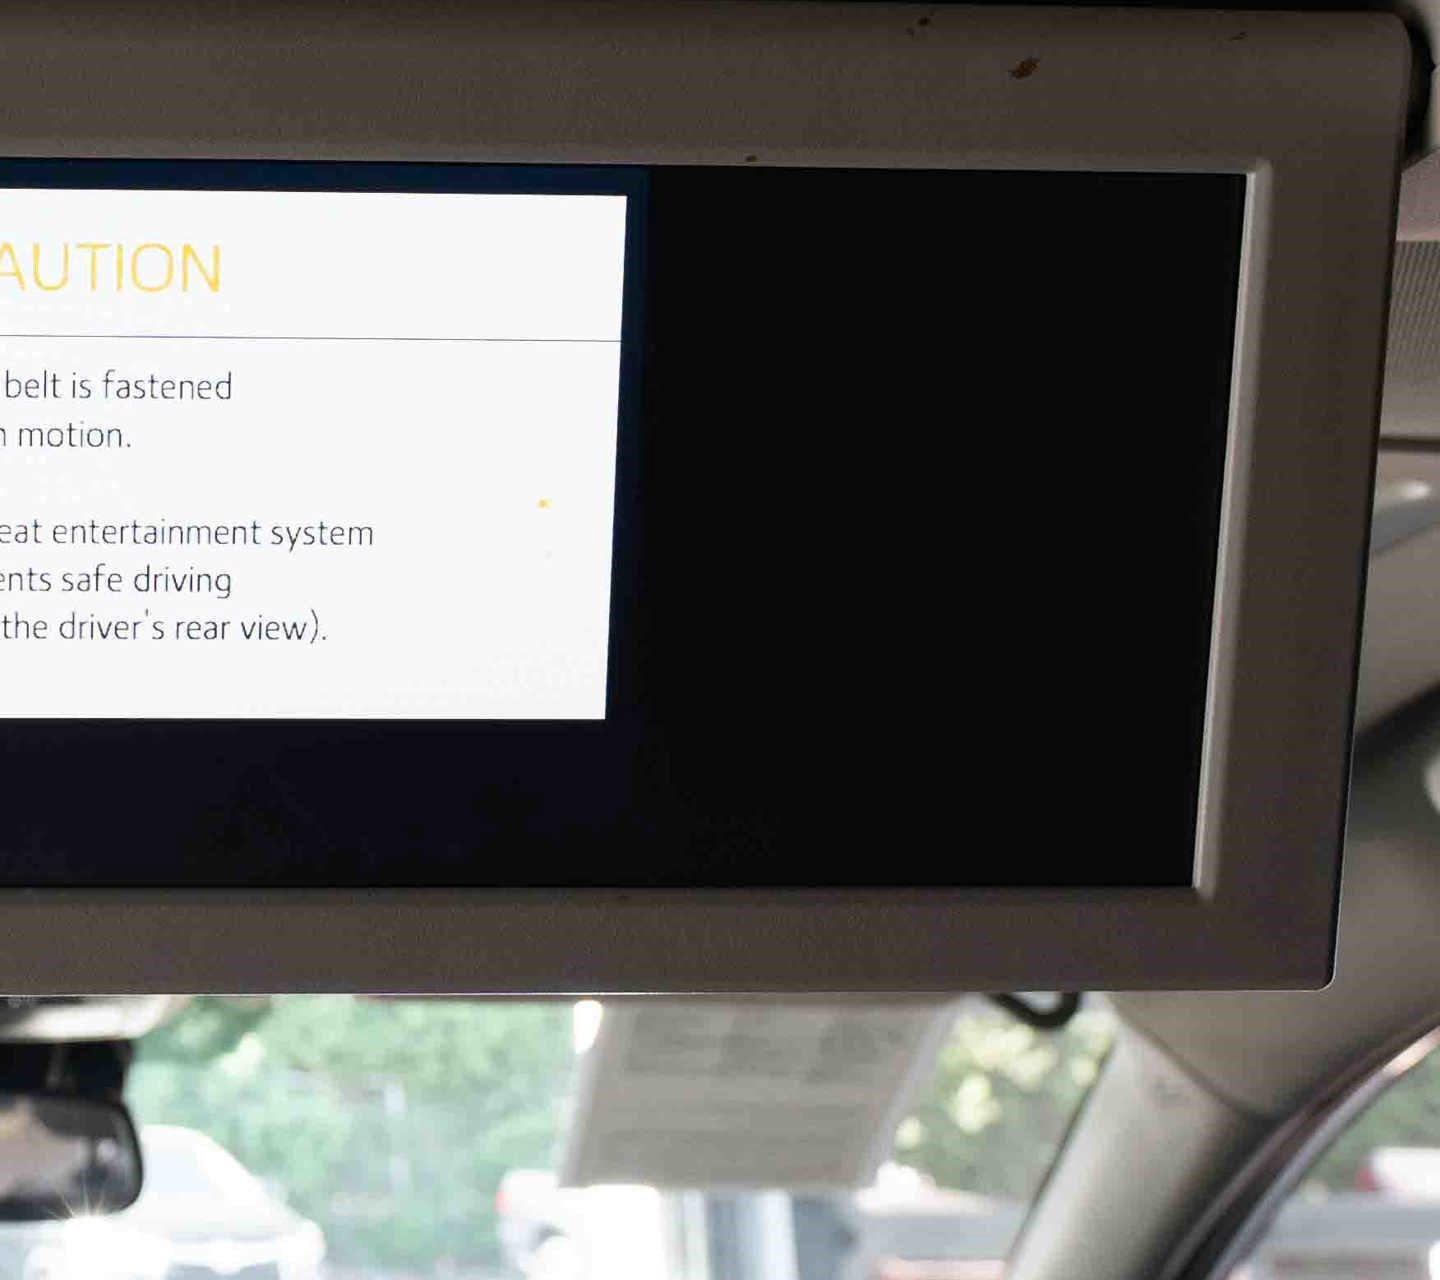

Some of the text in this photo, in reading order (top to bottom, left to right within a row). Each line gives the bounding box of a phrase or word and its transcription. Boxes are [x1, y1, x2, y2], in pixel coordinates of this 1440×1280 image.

[5, 369, 61, 399] belt
[72, 371, 92, 399] is
[102, 368, 232, 401] fastened
[18, 422, 131, 448] motion.
[52, 518, 262, 545] entertainment
[270, 521, 373, 553] system
[61, 562, 123, 593] safe
[133, 563, 231, 600] driving
[1, 611, 48, 640] the
[58, 608, 165, 641] driver's
[175, 620, 231, 641] rear
[240, 608, 327, 645] view).
